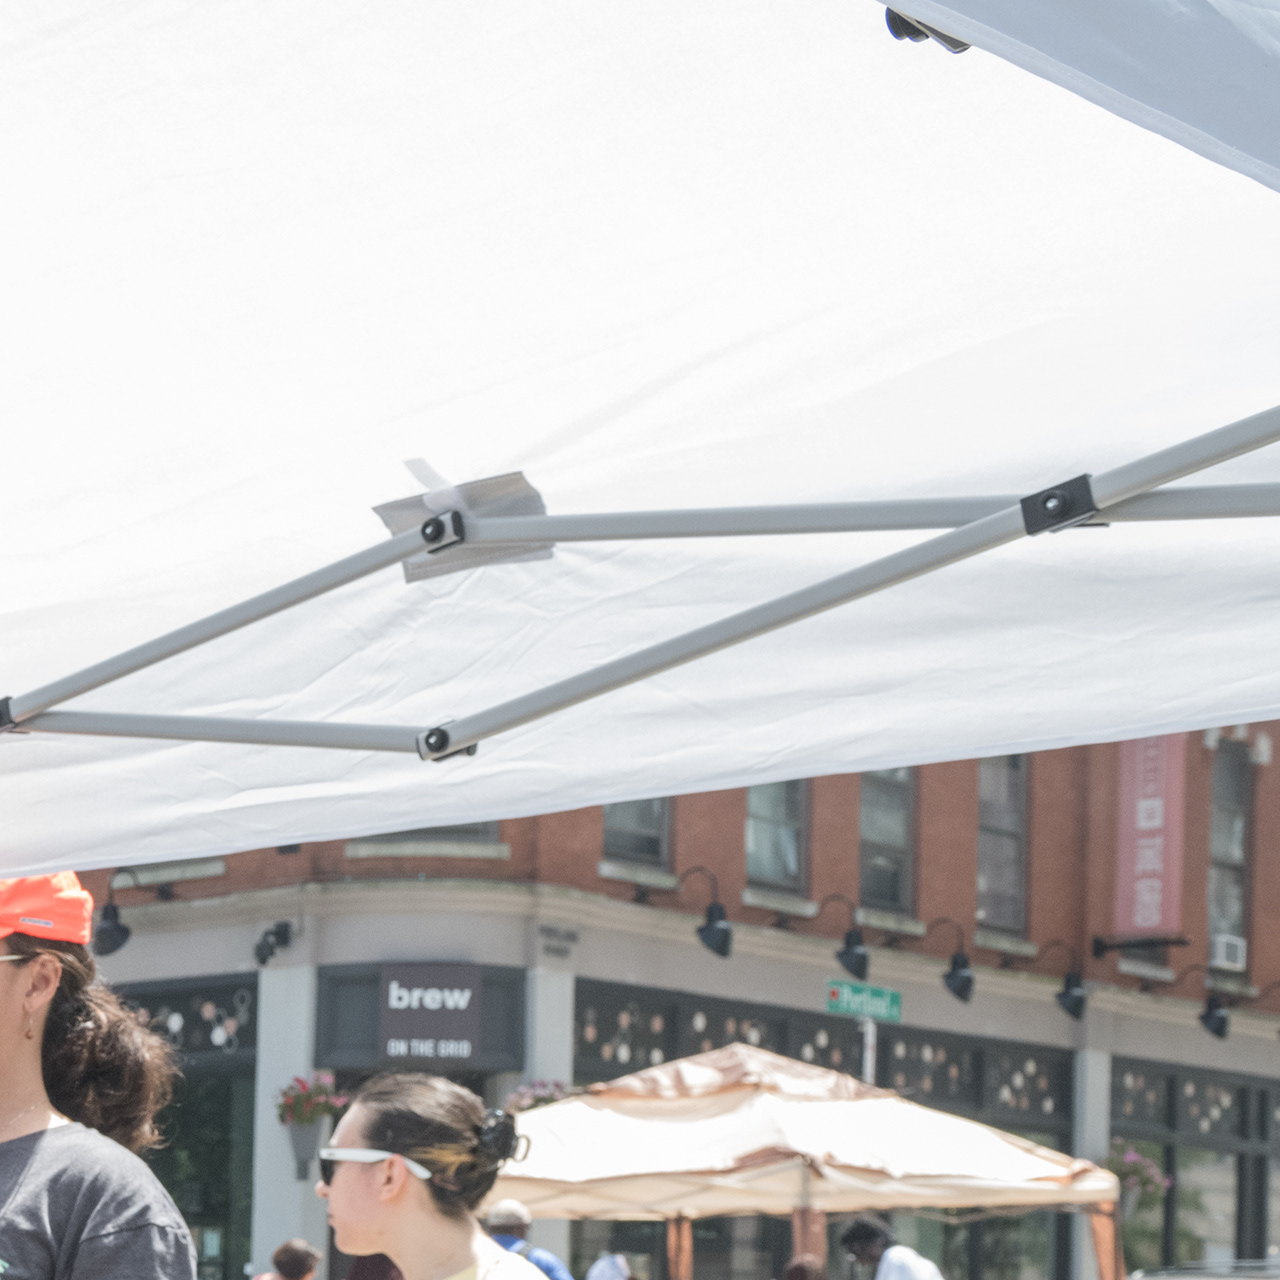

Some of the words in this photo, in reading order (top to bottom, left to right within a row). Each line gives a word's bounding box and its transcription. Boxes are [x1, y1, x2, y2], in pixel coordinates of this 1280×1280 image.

[388, 980, 472, 1010] brew
[386, 1038, 409, 1057] ON
[410, 1038, 436, 1057] THE
[437, 1039, 472, 1058] GRID
